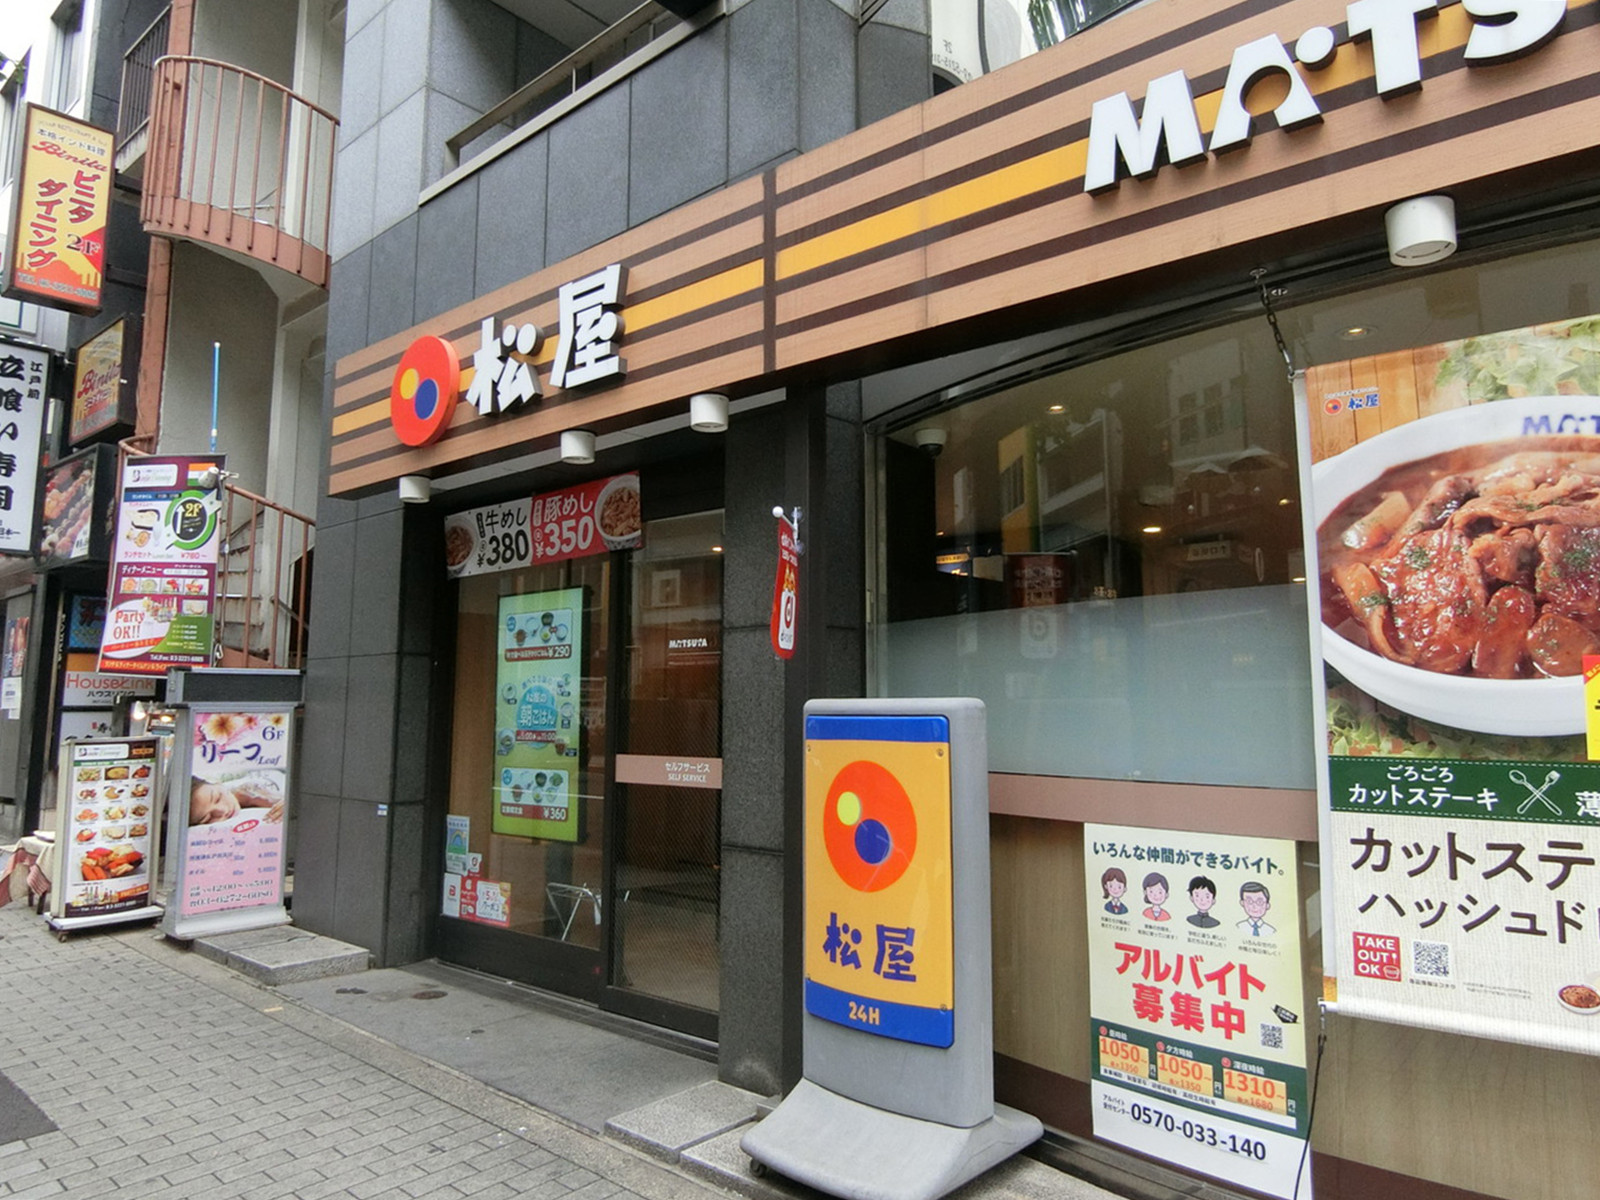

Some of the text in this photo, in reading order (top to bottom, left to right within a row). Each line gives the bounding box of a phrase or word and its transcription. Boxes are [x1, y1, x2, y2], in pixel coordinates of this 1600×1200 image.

[1083, 0, 1567, 193] MATS
[32, 141, 107, 172] Binita
[69, 170, 100, 224] ビニタ
[66, 233, 100, 255] 2F
[466, 264, 623, 415] 松屋
[1348, 393, 1379, 410] 松屋
[185, 503, 202, 517] 2F
[544, 492, 593, 522] 豚めし
[485, 507, 527, 534] 牛めし
[116, 610, 145, 624] Party
[113, 624, 140, 640] OK!!
[519, 704, 555, 727] 朝ごはん
[262, 726, 284, 741] 6F
[202, 742, 261, 764] リーフ
[258, 755, 281, 766] Leaf
[665, 762, 711, 773] セルフサービス
[1386, 765, 1454, 783] ごろごろ
[1348, 783, 1499, 812] カットステーキ
[1093, 841, 1284, 877] いろんな仲間ができるバイト。
[1350, 827, 1595, 891] カットステ
[1357, 893, 1600, 944] ハッシュド
[823, 912, 917, 983] 松屋
[1356, 935, 1395, 950] TAKE
[1357, 949, 1389, 963] OUT
[1358, 962, 1380, 975] OK
[1114, 942, 1266, 1000] アルバイト
[848, 1001, 880, 1026] 24H
[1132, 982, 1246, 1041] 募集中
[1131, 1103, 1266, 1161] 0570-033-140
